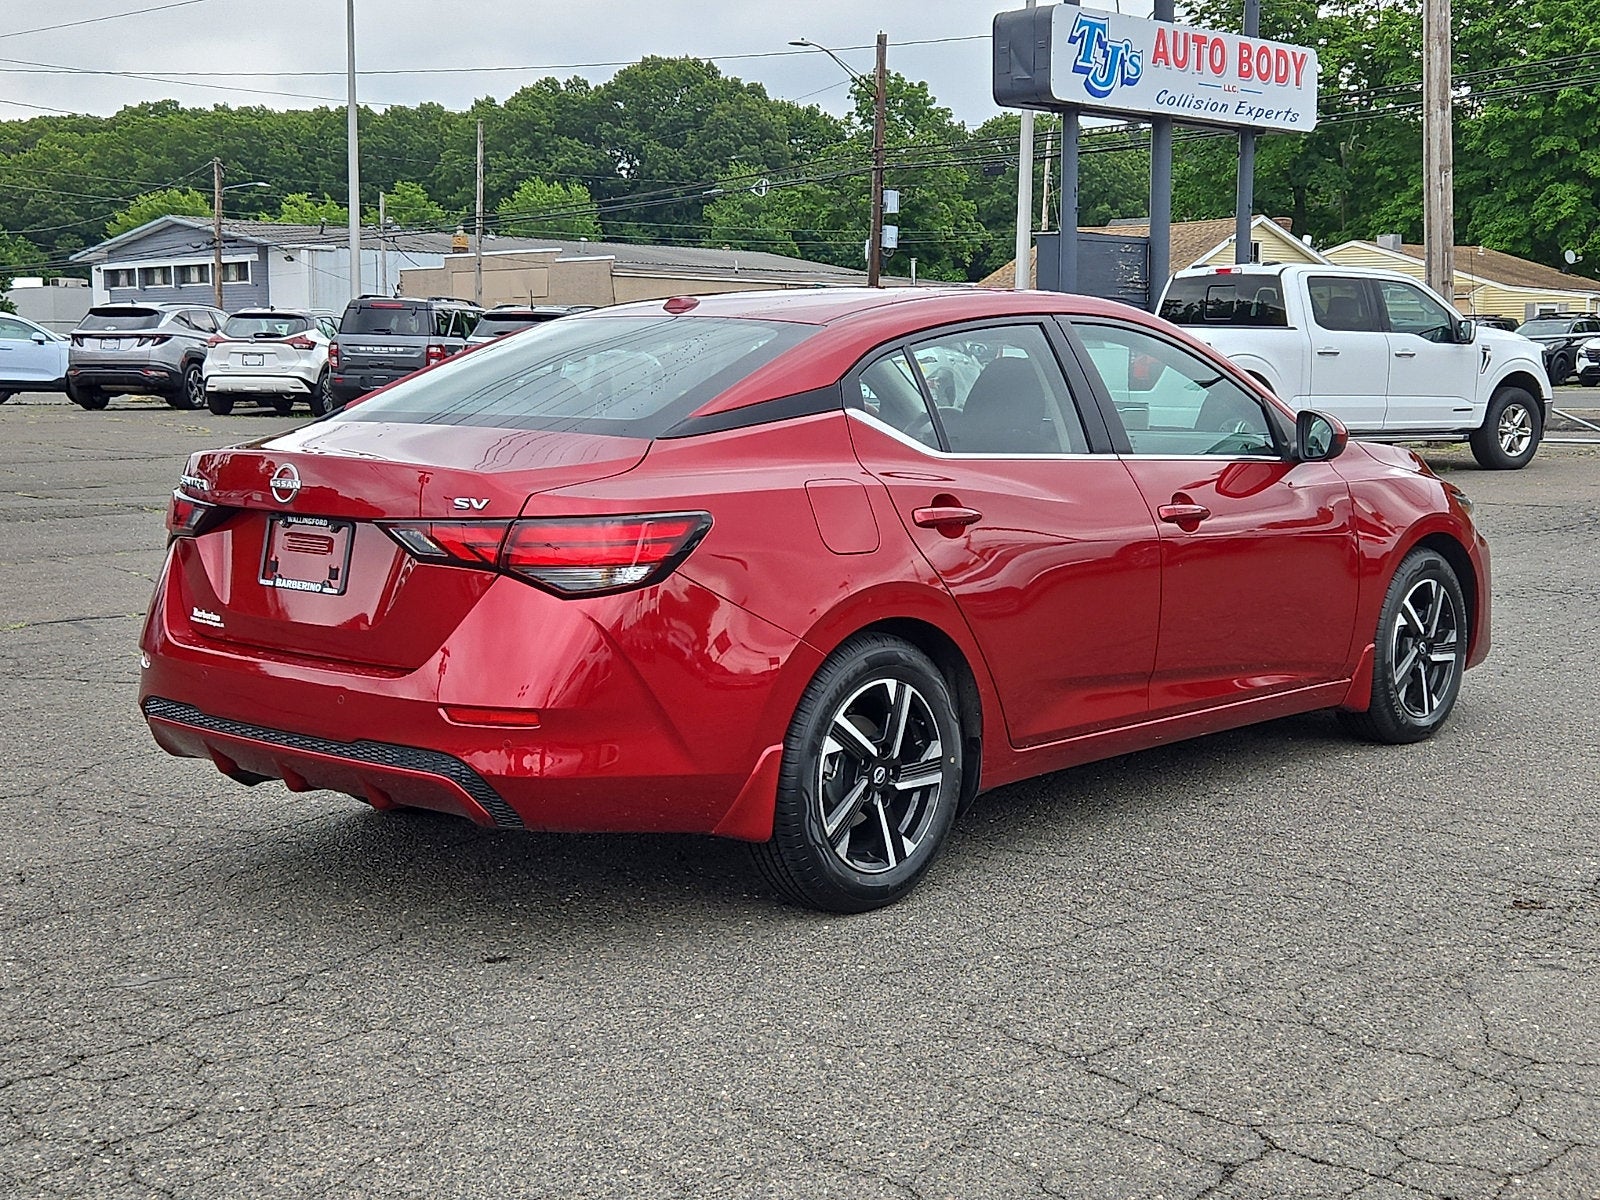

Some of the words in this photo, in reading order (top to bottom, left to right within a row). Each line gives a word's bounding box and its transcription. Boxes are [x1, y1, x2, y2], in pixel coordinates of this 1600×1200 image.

[1151, 27, 1227, 76] AUTO
[1237, 41, 1308, 88] BODY
[1155, 89, 1229, 113] Collision
[1234, 100, 1300, 123] Experts
[453, 497, 490, 510] SV
[287, 516, 328, 526] WALLINGFORD
[275, 578, 322, 592] BARBERINO
